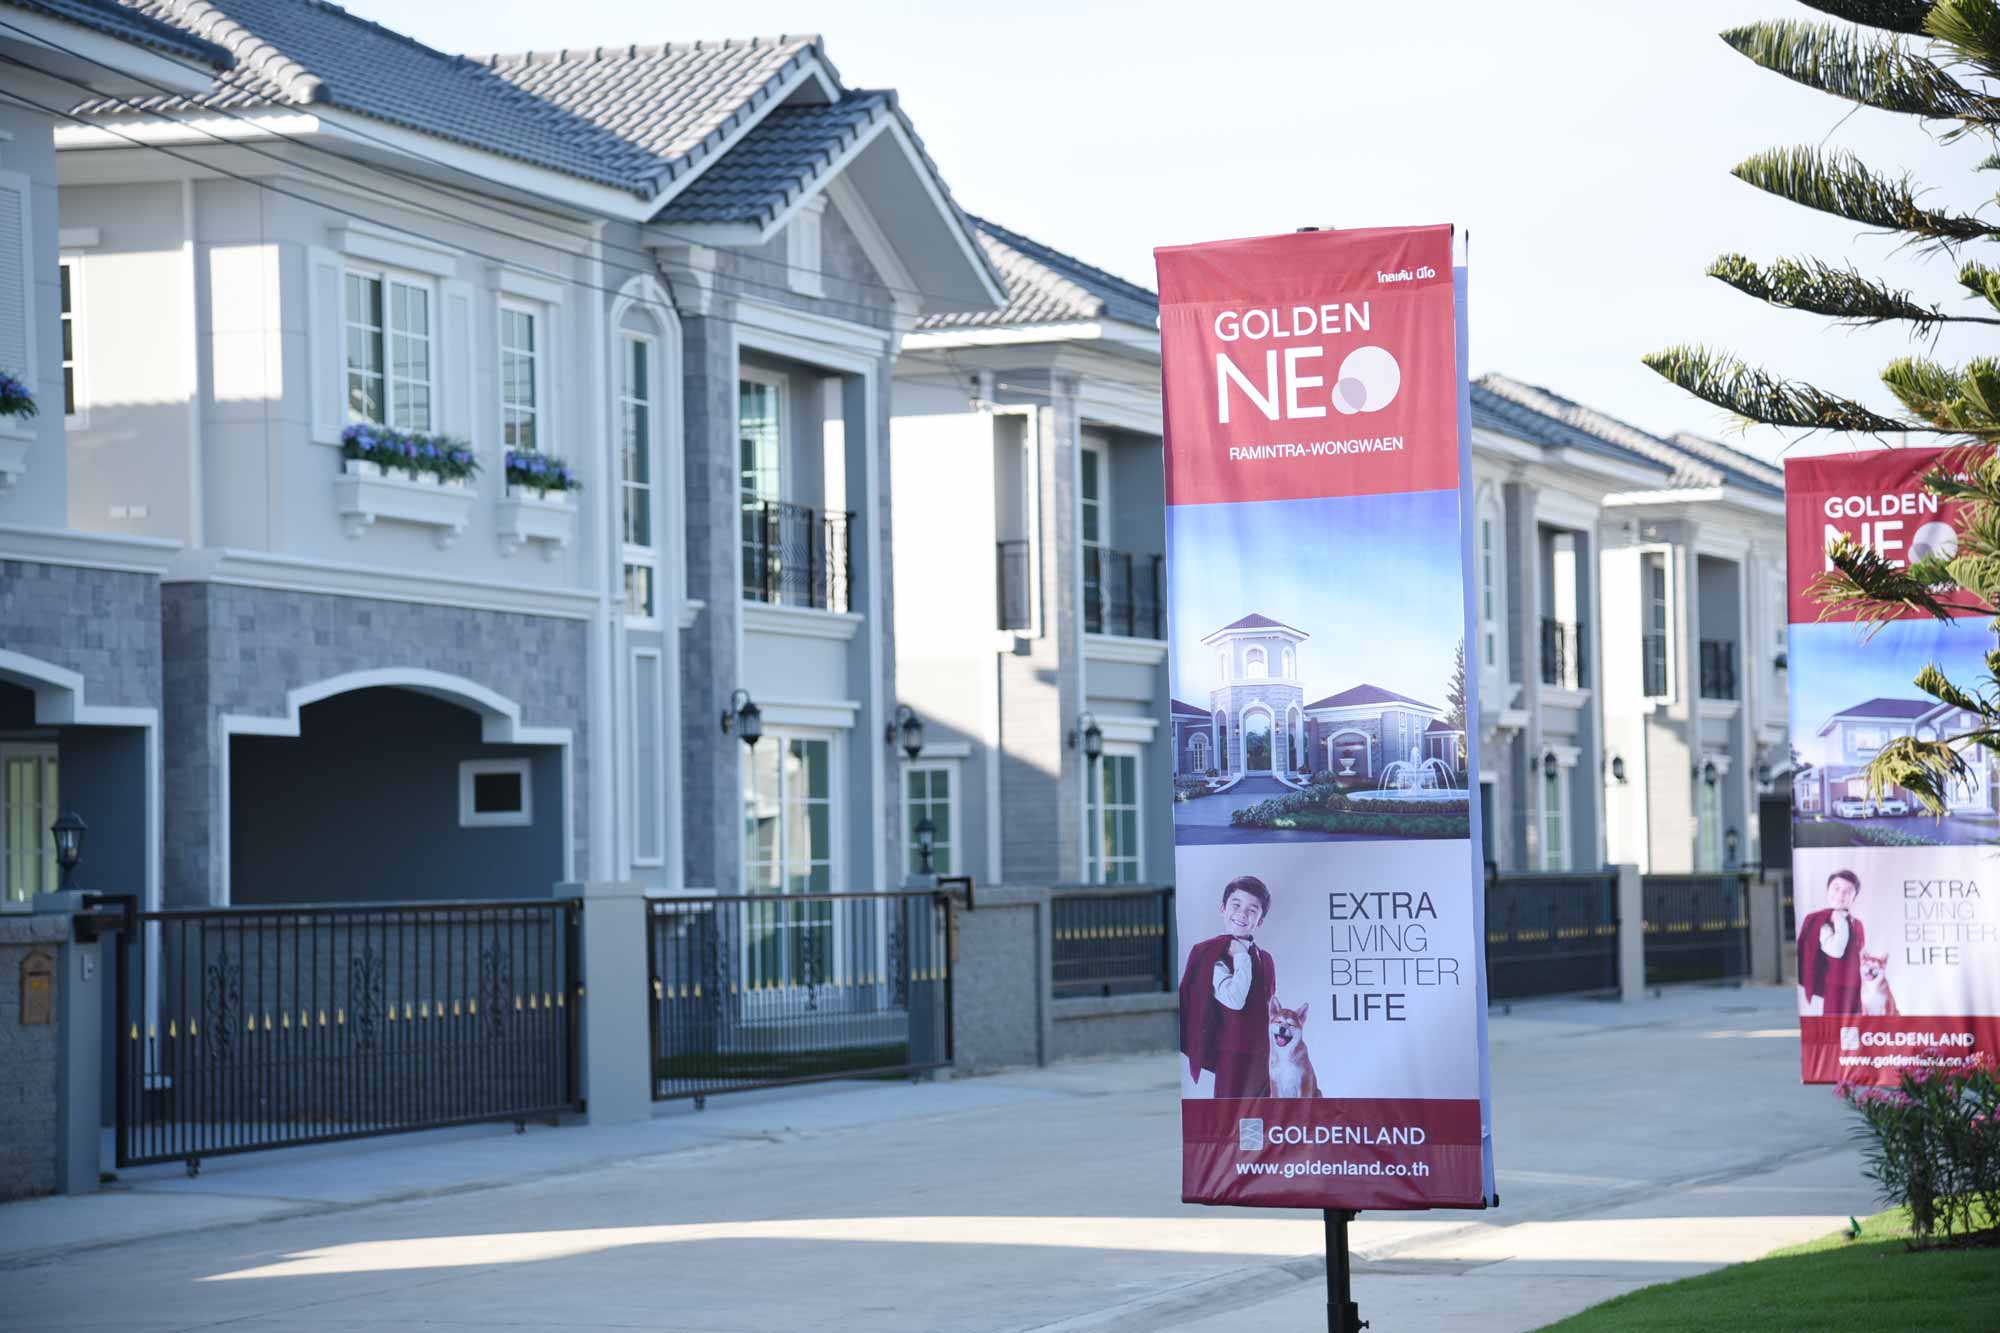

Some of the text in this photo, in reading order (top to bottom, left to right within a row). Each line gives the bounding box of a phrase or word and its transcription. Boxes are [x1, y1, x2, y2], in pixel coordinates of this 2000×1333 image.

[1416, 265, 1436, 280] นีโอ
[1214, 301, 1371, 342] GOLDEN
[1229, 436, 1404, 461] RAMINTRA-WONGWAEN
[1824, 493, 1938, 518] GOLDEN
[1903, 879, 1981, 899] EXTRA
[1329, 892, 1438, 920] EXTRA
[1904, 901, 1975, 921] LIVING
[1330, 923, 1428, 953] LIVING
[1904, 922, 1999, 943] BETTER
[1905, 946, 1961, 965] LIFE
[1331, 957, 1460, 987] BETTER
[1332, 993, 1406, 1022] LIFE
[1861, 1031, 1975, 1047] GOLDENLAND
[1268, 1126, 1425, 1146] GOLDENLAND
[1235, 1158, 1430, 1178] www.goldenland.co.th
